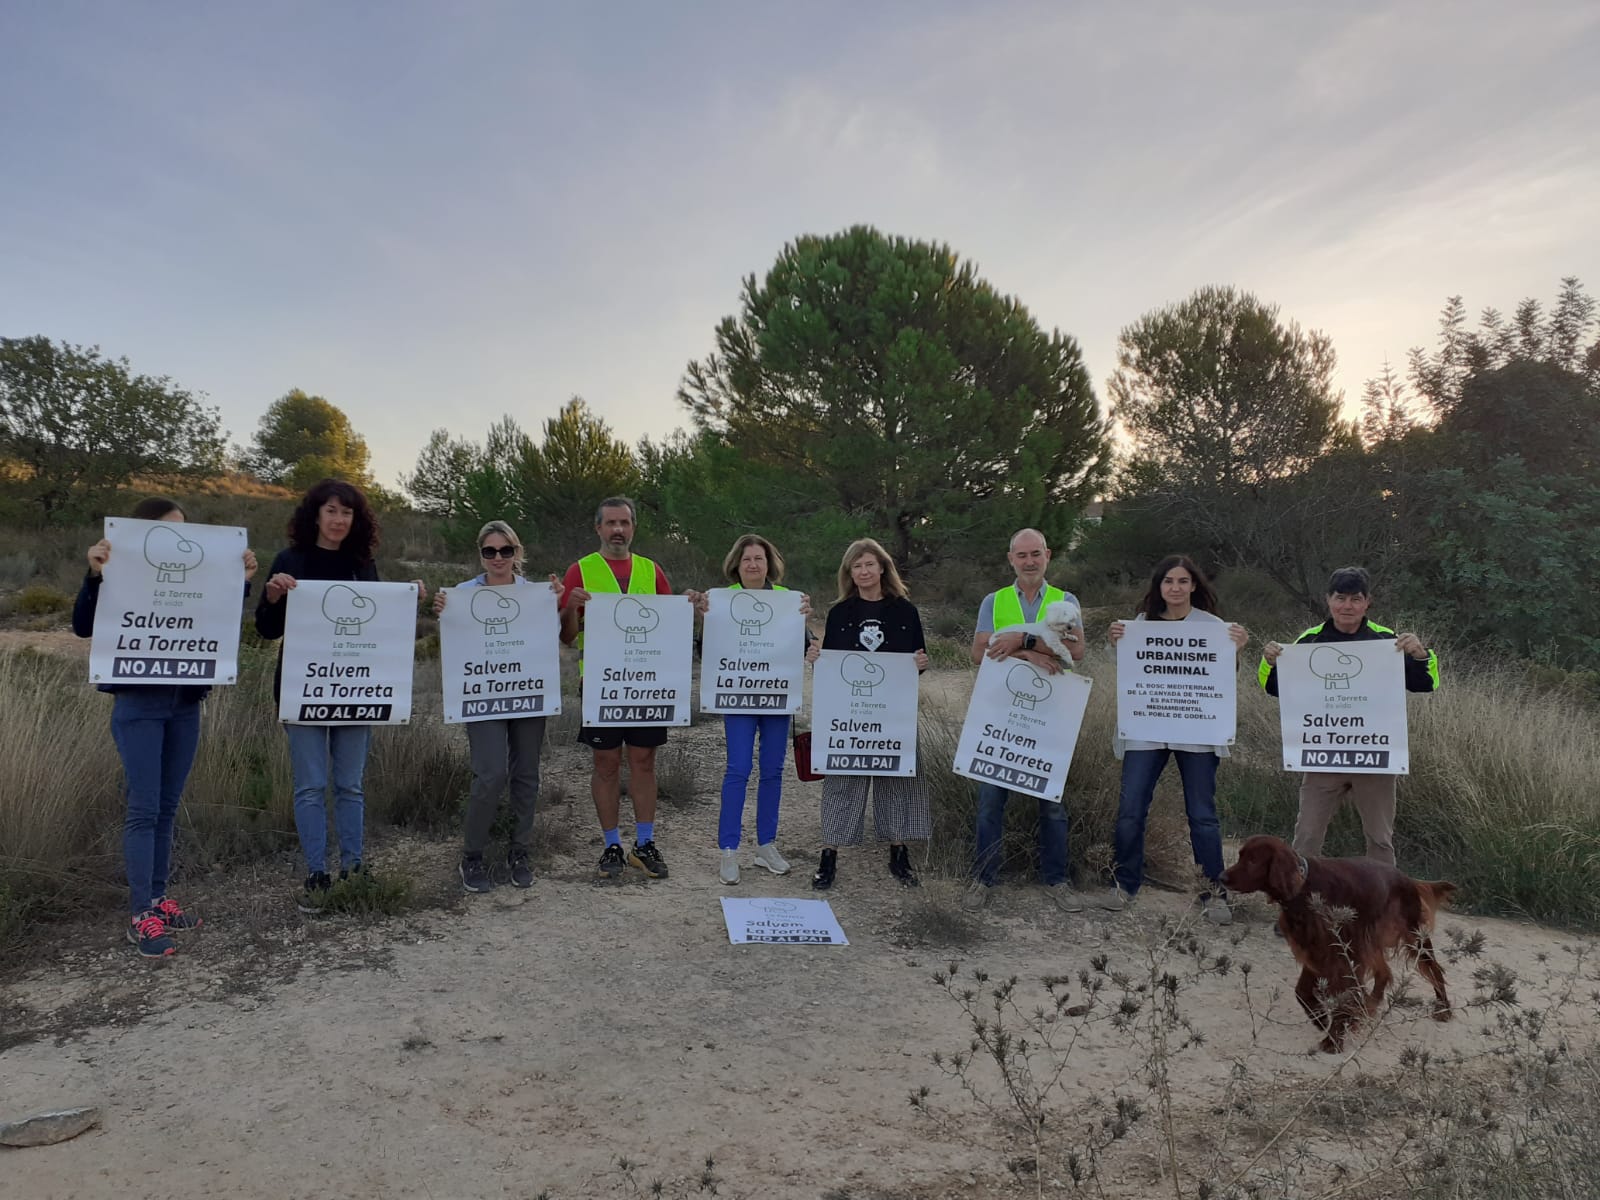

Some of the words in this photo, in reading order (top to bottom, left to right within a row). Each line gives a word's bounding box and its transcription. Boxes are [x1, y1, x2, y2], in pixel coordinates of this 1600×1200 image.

[168, 590, 203, 599] Torreta
[121, 612, 193, 629] Salvem
[117, 635, 140, 650] La
[149, 636, 218, 652] Torreta
[1146, 637, 1183, 647] PROU
[1189, 639, 1207, 648] DE
[1137, 651, 1217, 662] URBANISME
[119, 661, 146, 674] NO
[150, 662, 172, 675] AL
[177, 662, 205, 675] PAI
[306, 662, 370, 678] Salvem
[464, 661, 521, 676] Salvem
[719, 658, 769, 672] Salvem
[1144, 665, 1209, 675] CRIMINAL
[603, 668, 656, 681] Salvem
[463, 682, 481, 695] La
[487, 678, 544, 692] Torreta
[717, 675, 733, 688] La
[738, 676, 789, 689] Torreta
[303, 684, 323, 697] La
[330, 684, 393, 697] Torreta
[601, 687, 618, 700] La
[624, 687, 676, 699] Torreta
[467, 702, 488, 714] NO
[491, 700, 509, 712] AL
[512, 698, 535, 710] PAI
[720, 696, 737, 706] NO
[740, 696, 756, 706] AL
[759, 696, 780, 707] PAI
[304, 707, 328, 719] NO
[331, 707, 351, 719] AL
[356, 707, 382, 719] PAI
[603, 708, 622, 719] NO
[625, 708, 642, 719] AL
[646, 708, 667, 719] PAI
[1020, 713, 1046, 726] Torreta
[830, 719, 882, 733] Salvem
[1304, 714, 1364, 727] Salvem
[828, 736, 844, 749] La
[850, 737, 901, 750] Torreta
[983, 724, 1036, 750] Salvem
[1302, 732, 1321, 744] La
[1327, 732, 1389, 745] Torreta
[831, 757, 849, 768] NO
[853, 757, 867, 768] AL
[872, 758, 893, 768] PAI
[977, 741, 994, 756] La
[1000, 746, 1053, 773] Torreta
[1306, 752, 1328, 764] NO
[1332, 753, 1350, 764] AL
[1355, 753, 1380, 765] PAI
[974, 761, 995, 775] NO
[996, 769, 1012, 780] AL
[1016, 774, 1040, 789] PAI
